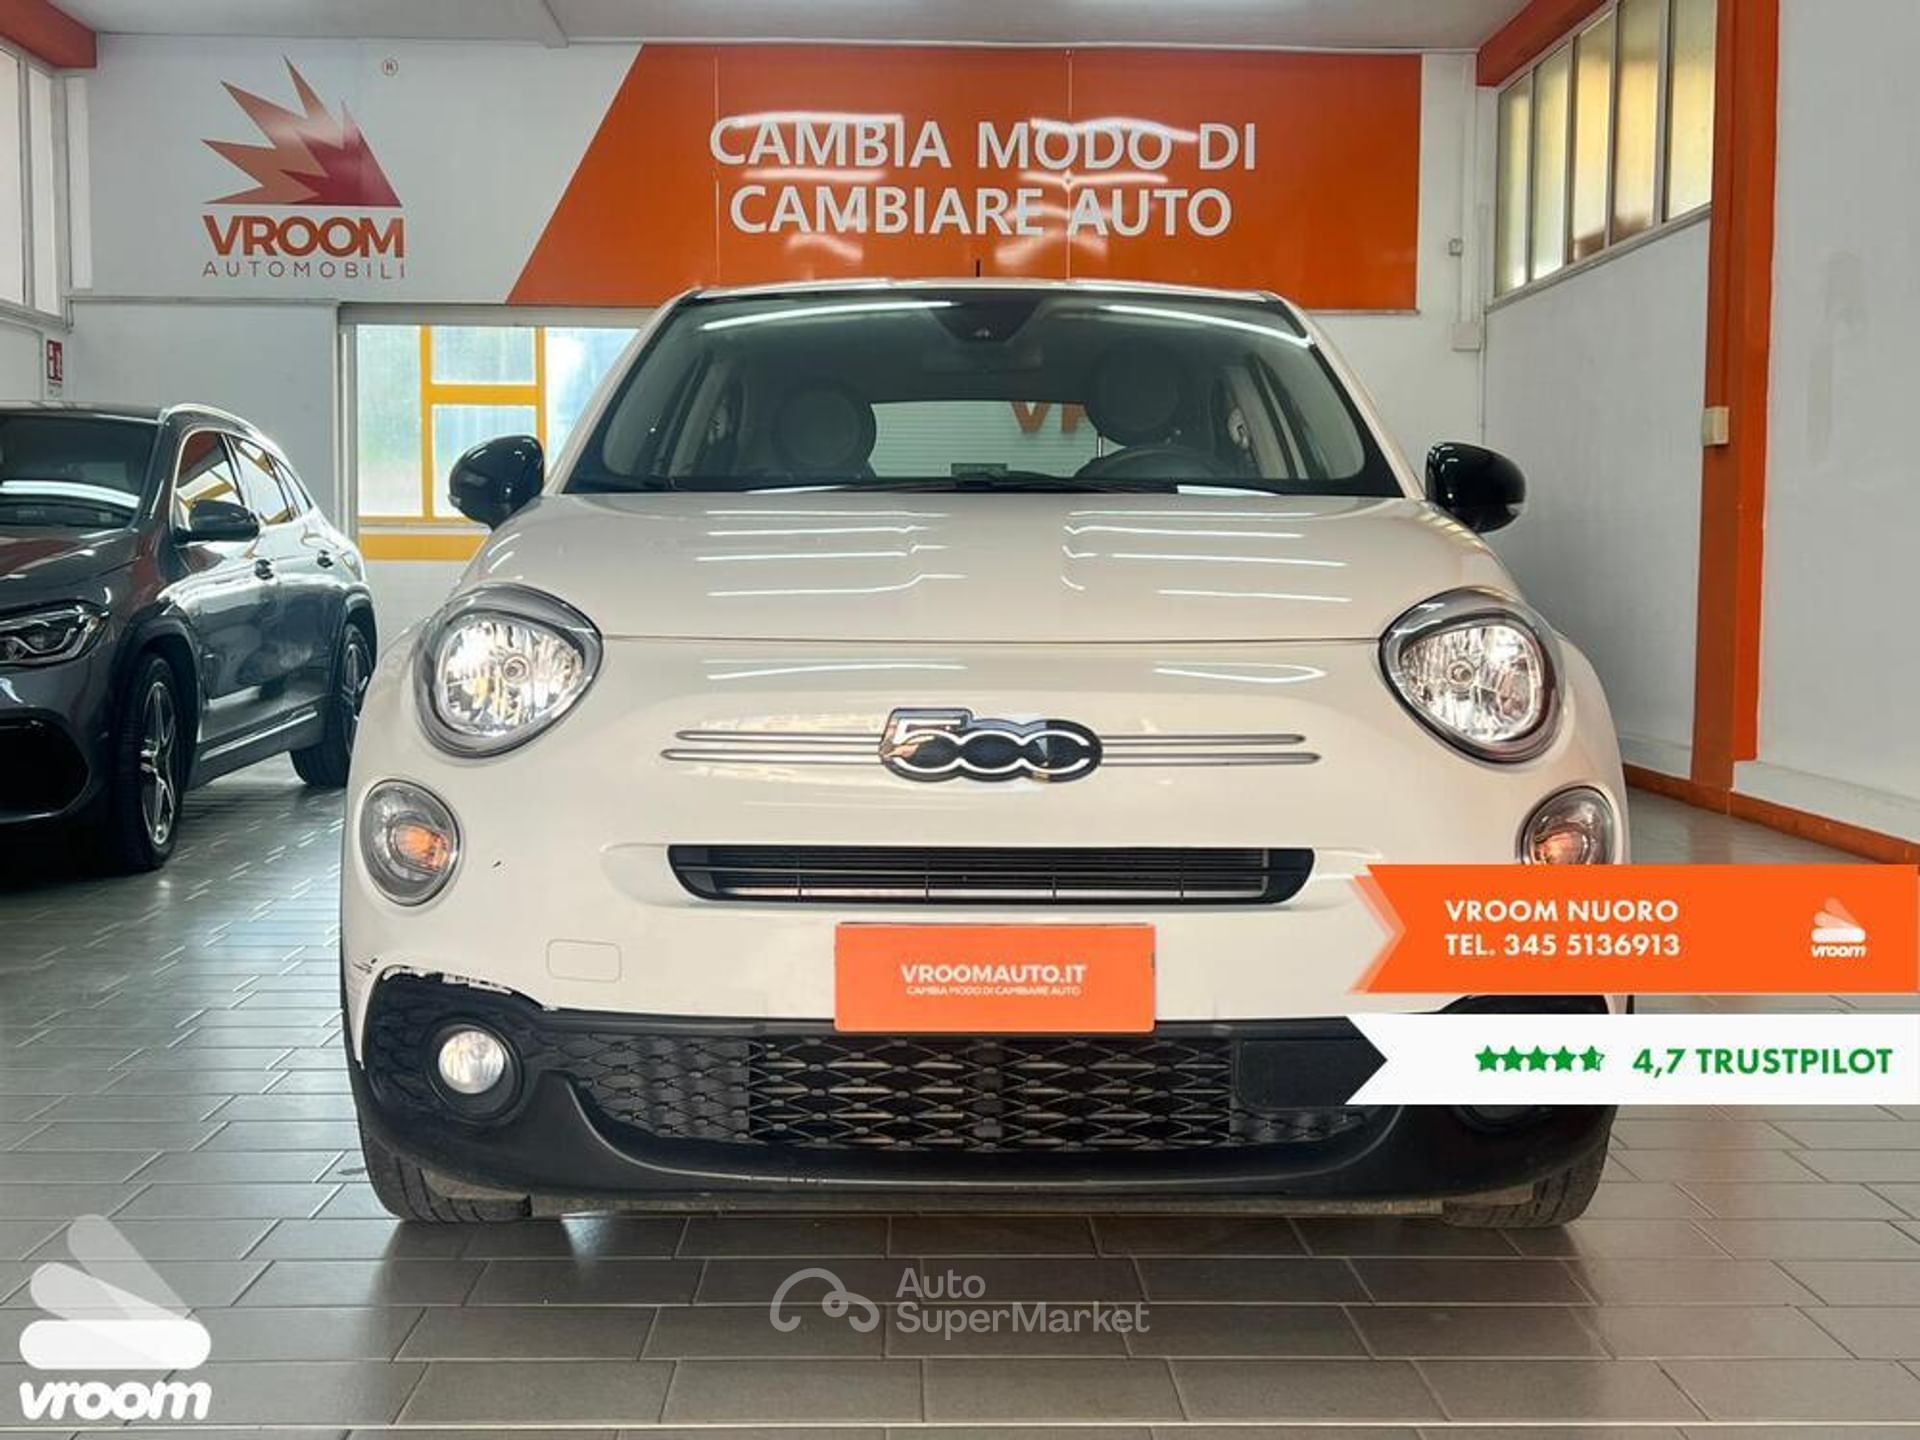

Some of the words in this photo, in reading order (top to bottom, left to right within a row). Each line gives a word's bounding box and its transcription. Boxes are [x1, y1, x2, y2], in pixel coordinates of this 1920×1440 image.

[710, 120, 950, 168] CAMBIA
[977, 121, 1173, 170] MODO
[1198, 122, 1256, 170] DI
[730, 185, 1043, 235] CAMBIARE
[1067, 188, 1232, 237] AUTO
[202, 215, 404, 258] VROOM
[202, 261, 405, 280] AUTOMOBILI
[901, 965, 1086, 984] VROOMAUTO.IT
[1051, 986, 1082, 996] AUTO
